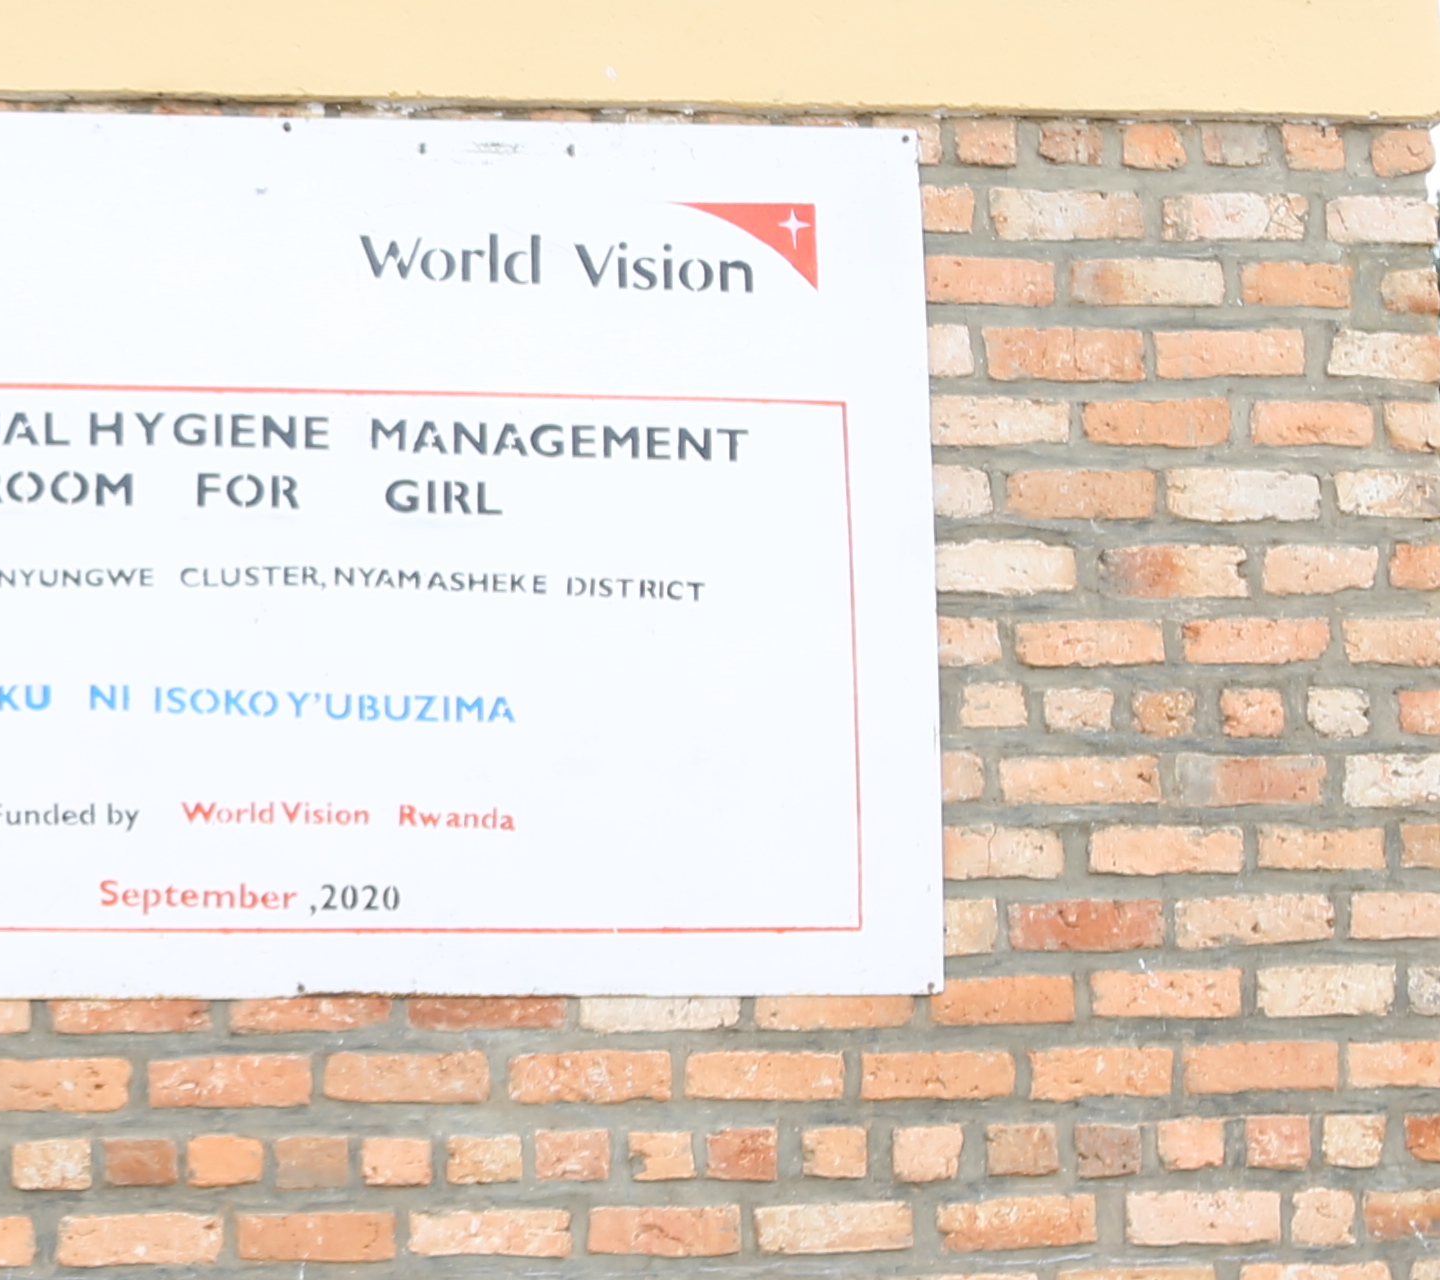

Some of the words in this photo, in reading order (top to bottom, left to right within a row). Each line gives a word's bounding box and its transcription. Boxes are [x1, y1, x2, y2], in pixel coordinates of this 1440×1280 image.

[359, 233, 541, 285] World
[574, 241, 754, 293] Vision
[89, 411, 329, 450] HYGIENE
[370, 417, 749, 462] MANAGEMENT
[196, 472, 300, 510] FOR
[384, 478, 503, 516] GIRL
[566, 577, 706, 602] DISTRICT
[89, 684, 130, 711] NI
[107, 803, 140, 831] by
[181, 802, 274, 825] World
[281, 802, 371, 826] Vision
[399, 804, 516, 831] Rwanda
[99, 879, 299, 916] September
